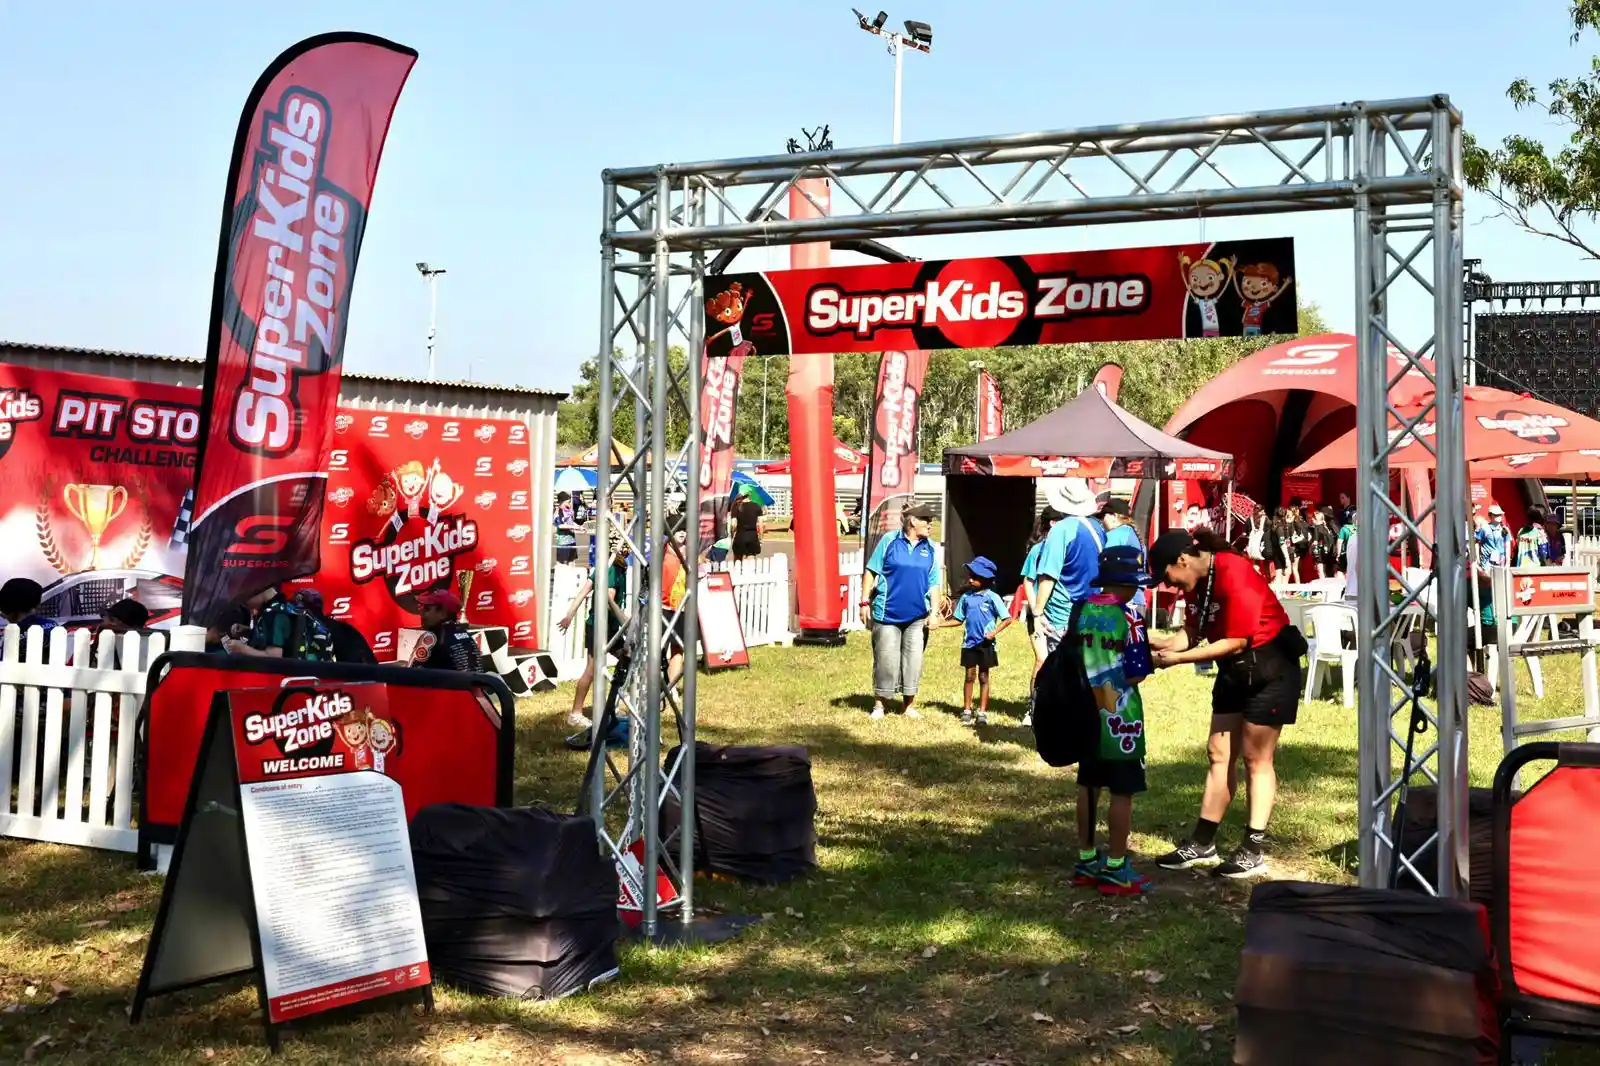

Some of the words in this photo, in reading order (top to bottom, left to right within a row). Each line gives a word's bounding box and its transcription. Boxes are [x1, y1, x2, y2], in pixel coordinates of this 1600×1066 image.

[235, 98, 320, 447] SuperKids
[293, 194, 345, 356] Zone
[809, 277, 1025, 333] SuperKids
[1034, 276, 1145, 315] Zone
[58, 398, 121, 432] PIT
[132, 406, 199, 440] STO
[714, 370, 736, 444] Zone
[90, 446, 197, 468] CHALLENG
[352, 520, 476, 578] SuperKids
[395, 555, 450, 595] Zone
[527, 665, 536, 684] 3
[245, 692, 352, 741] SuperKids
[284, 720, 332, 752] Zone
[263, 754, 344, 774] WELCOME
[1120, 735, 1136, 754] 6
